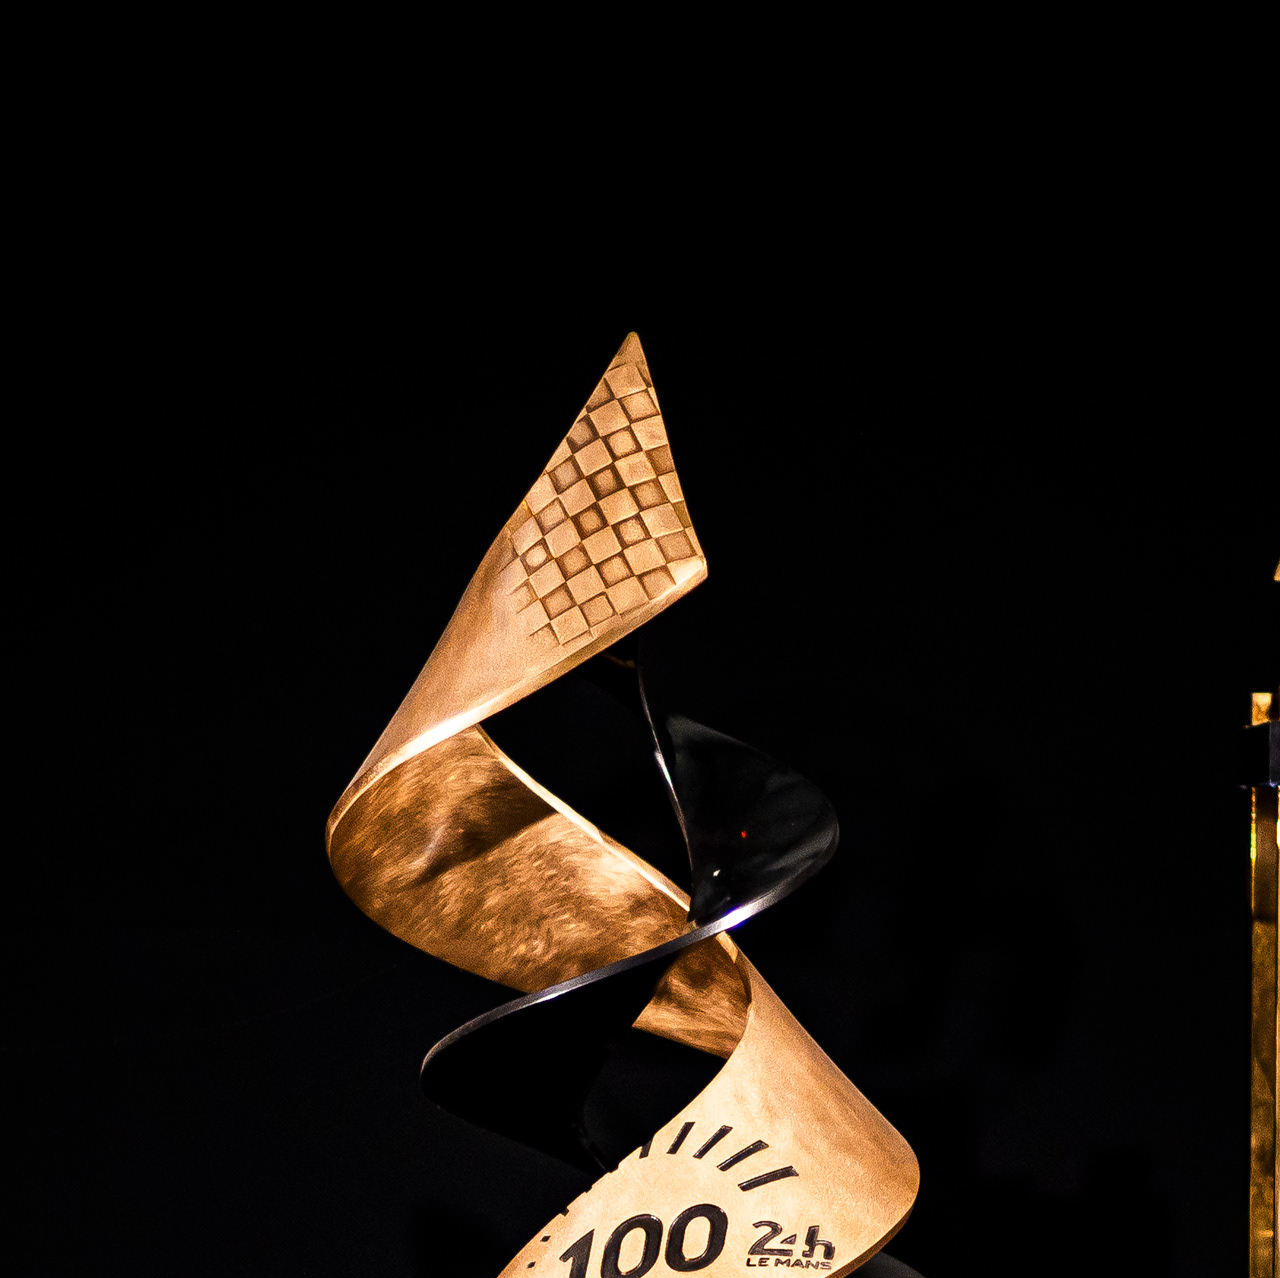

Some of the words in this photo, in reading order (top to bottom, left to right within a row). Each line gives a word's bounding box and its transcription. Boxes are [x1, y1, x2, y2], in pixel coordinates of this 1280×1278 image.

[748, 1220, 835, 1260] 24h
[746, 1257, 770, 1267] LE
[774, 1258, 832, 1270] MANS
